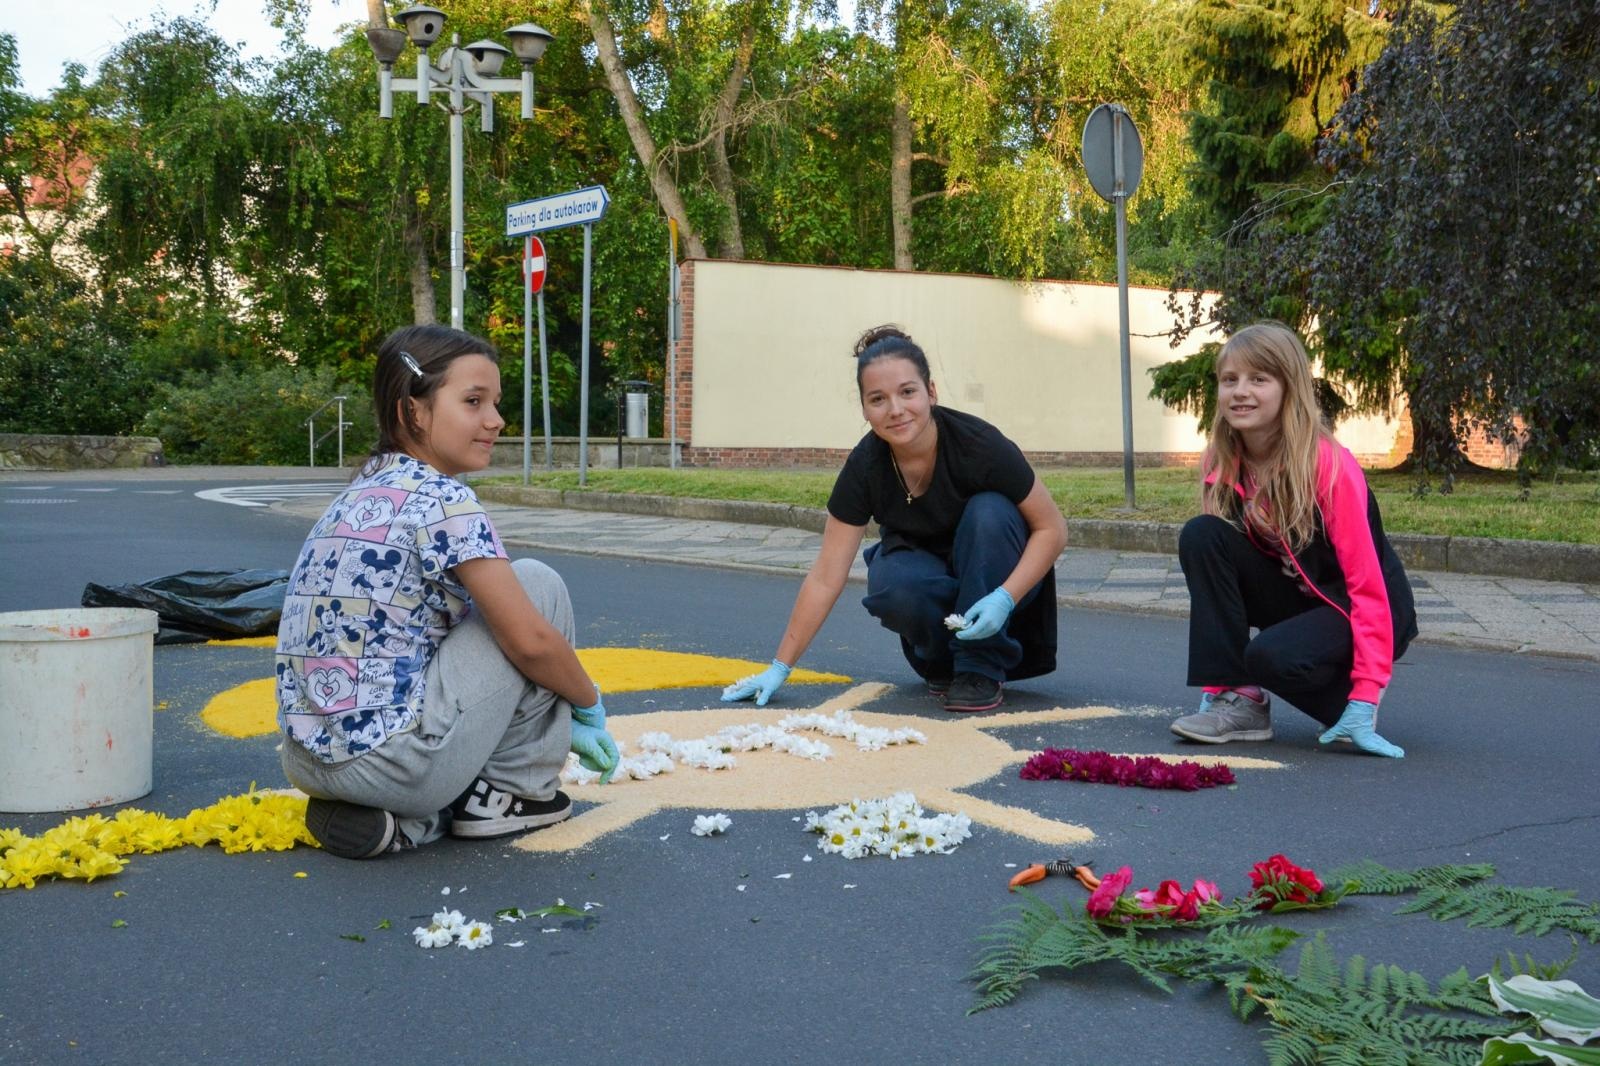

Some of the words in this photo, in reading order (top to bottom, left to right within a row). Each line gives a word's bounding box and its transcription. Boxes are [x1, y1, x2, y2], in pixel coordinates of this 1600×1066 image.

[508, 211, 536, 228] Parking
[539, 206, 551, 221] dla
[554, 197, 598, 219] autokarów
